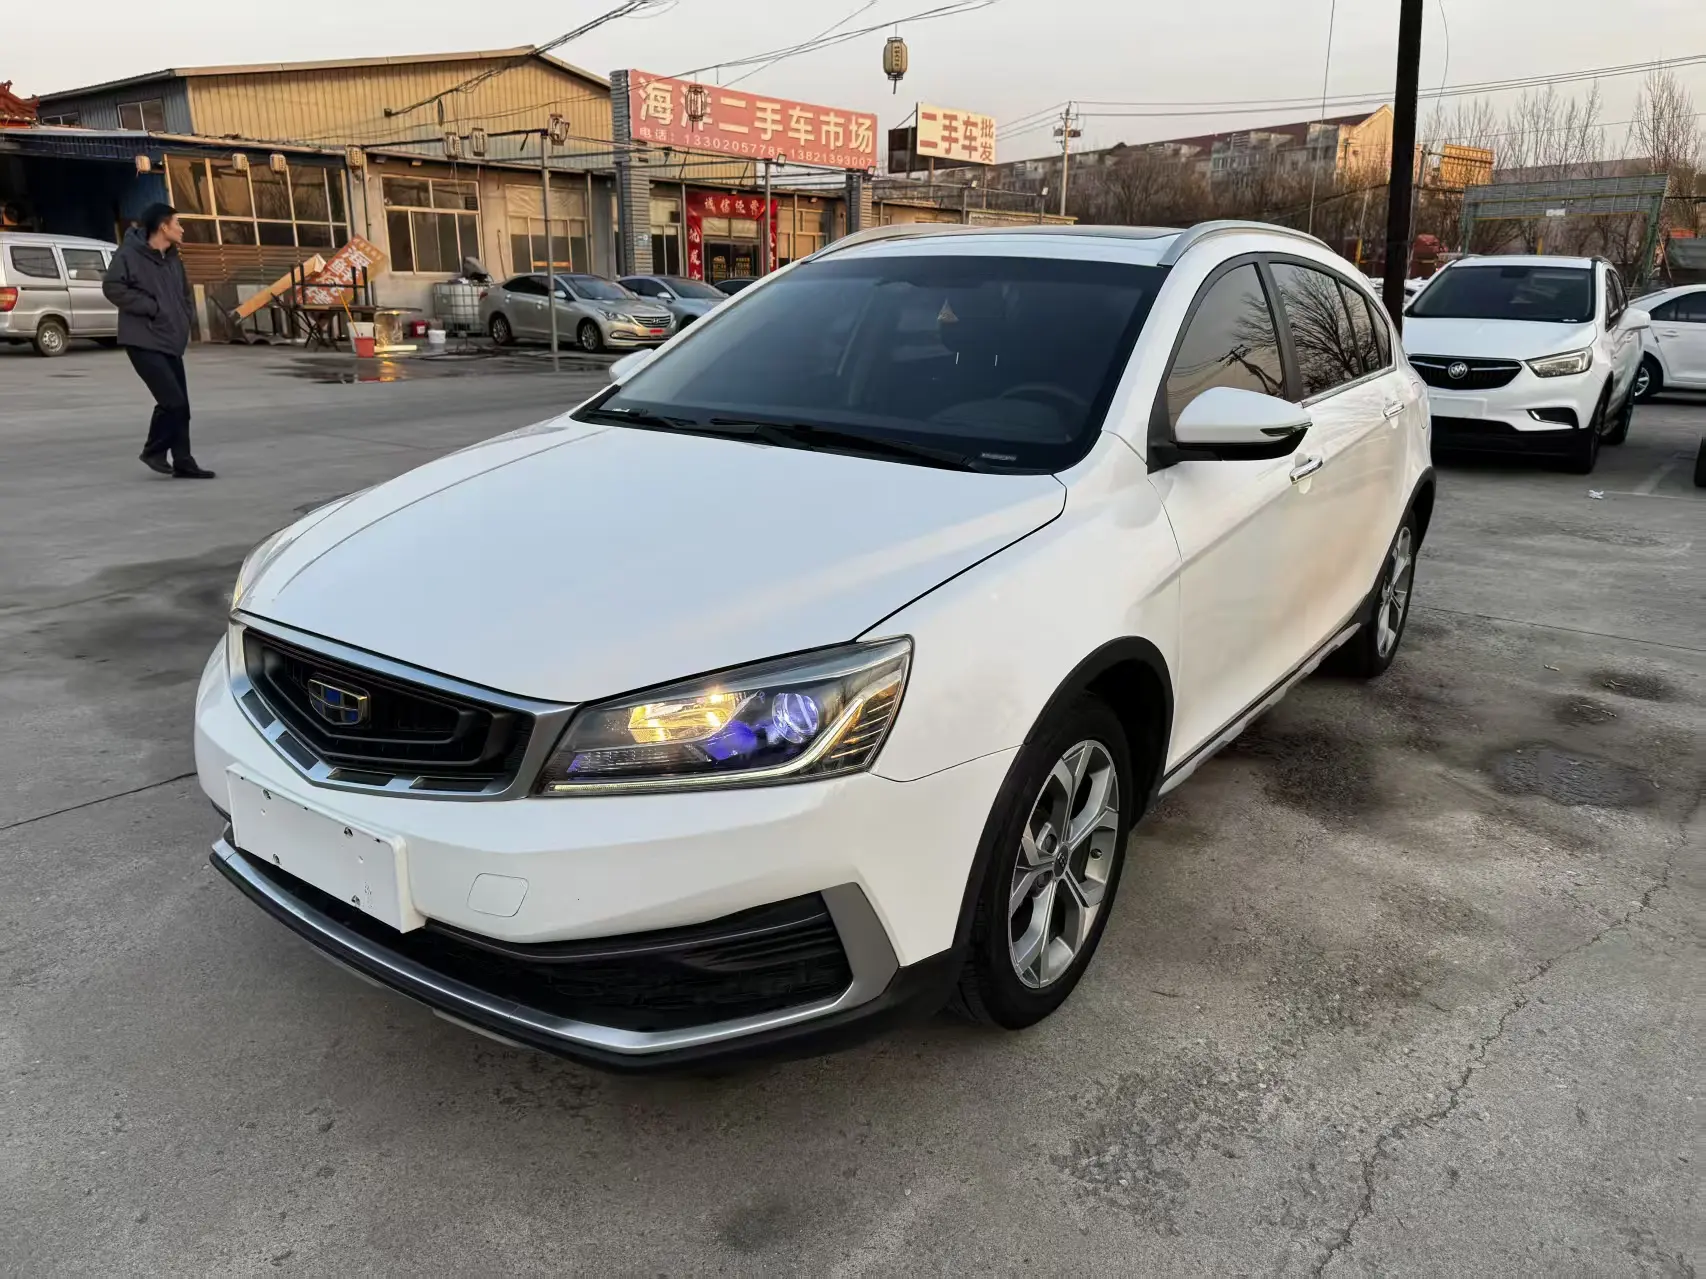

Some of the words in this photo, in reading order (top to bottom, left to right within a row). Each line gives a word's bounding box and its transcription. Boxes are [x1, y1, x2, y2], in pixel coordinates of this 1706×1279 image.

[919, 111, 979, 159] 二手车
[979, 117, 994, 162] 批发
